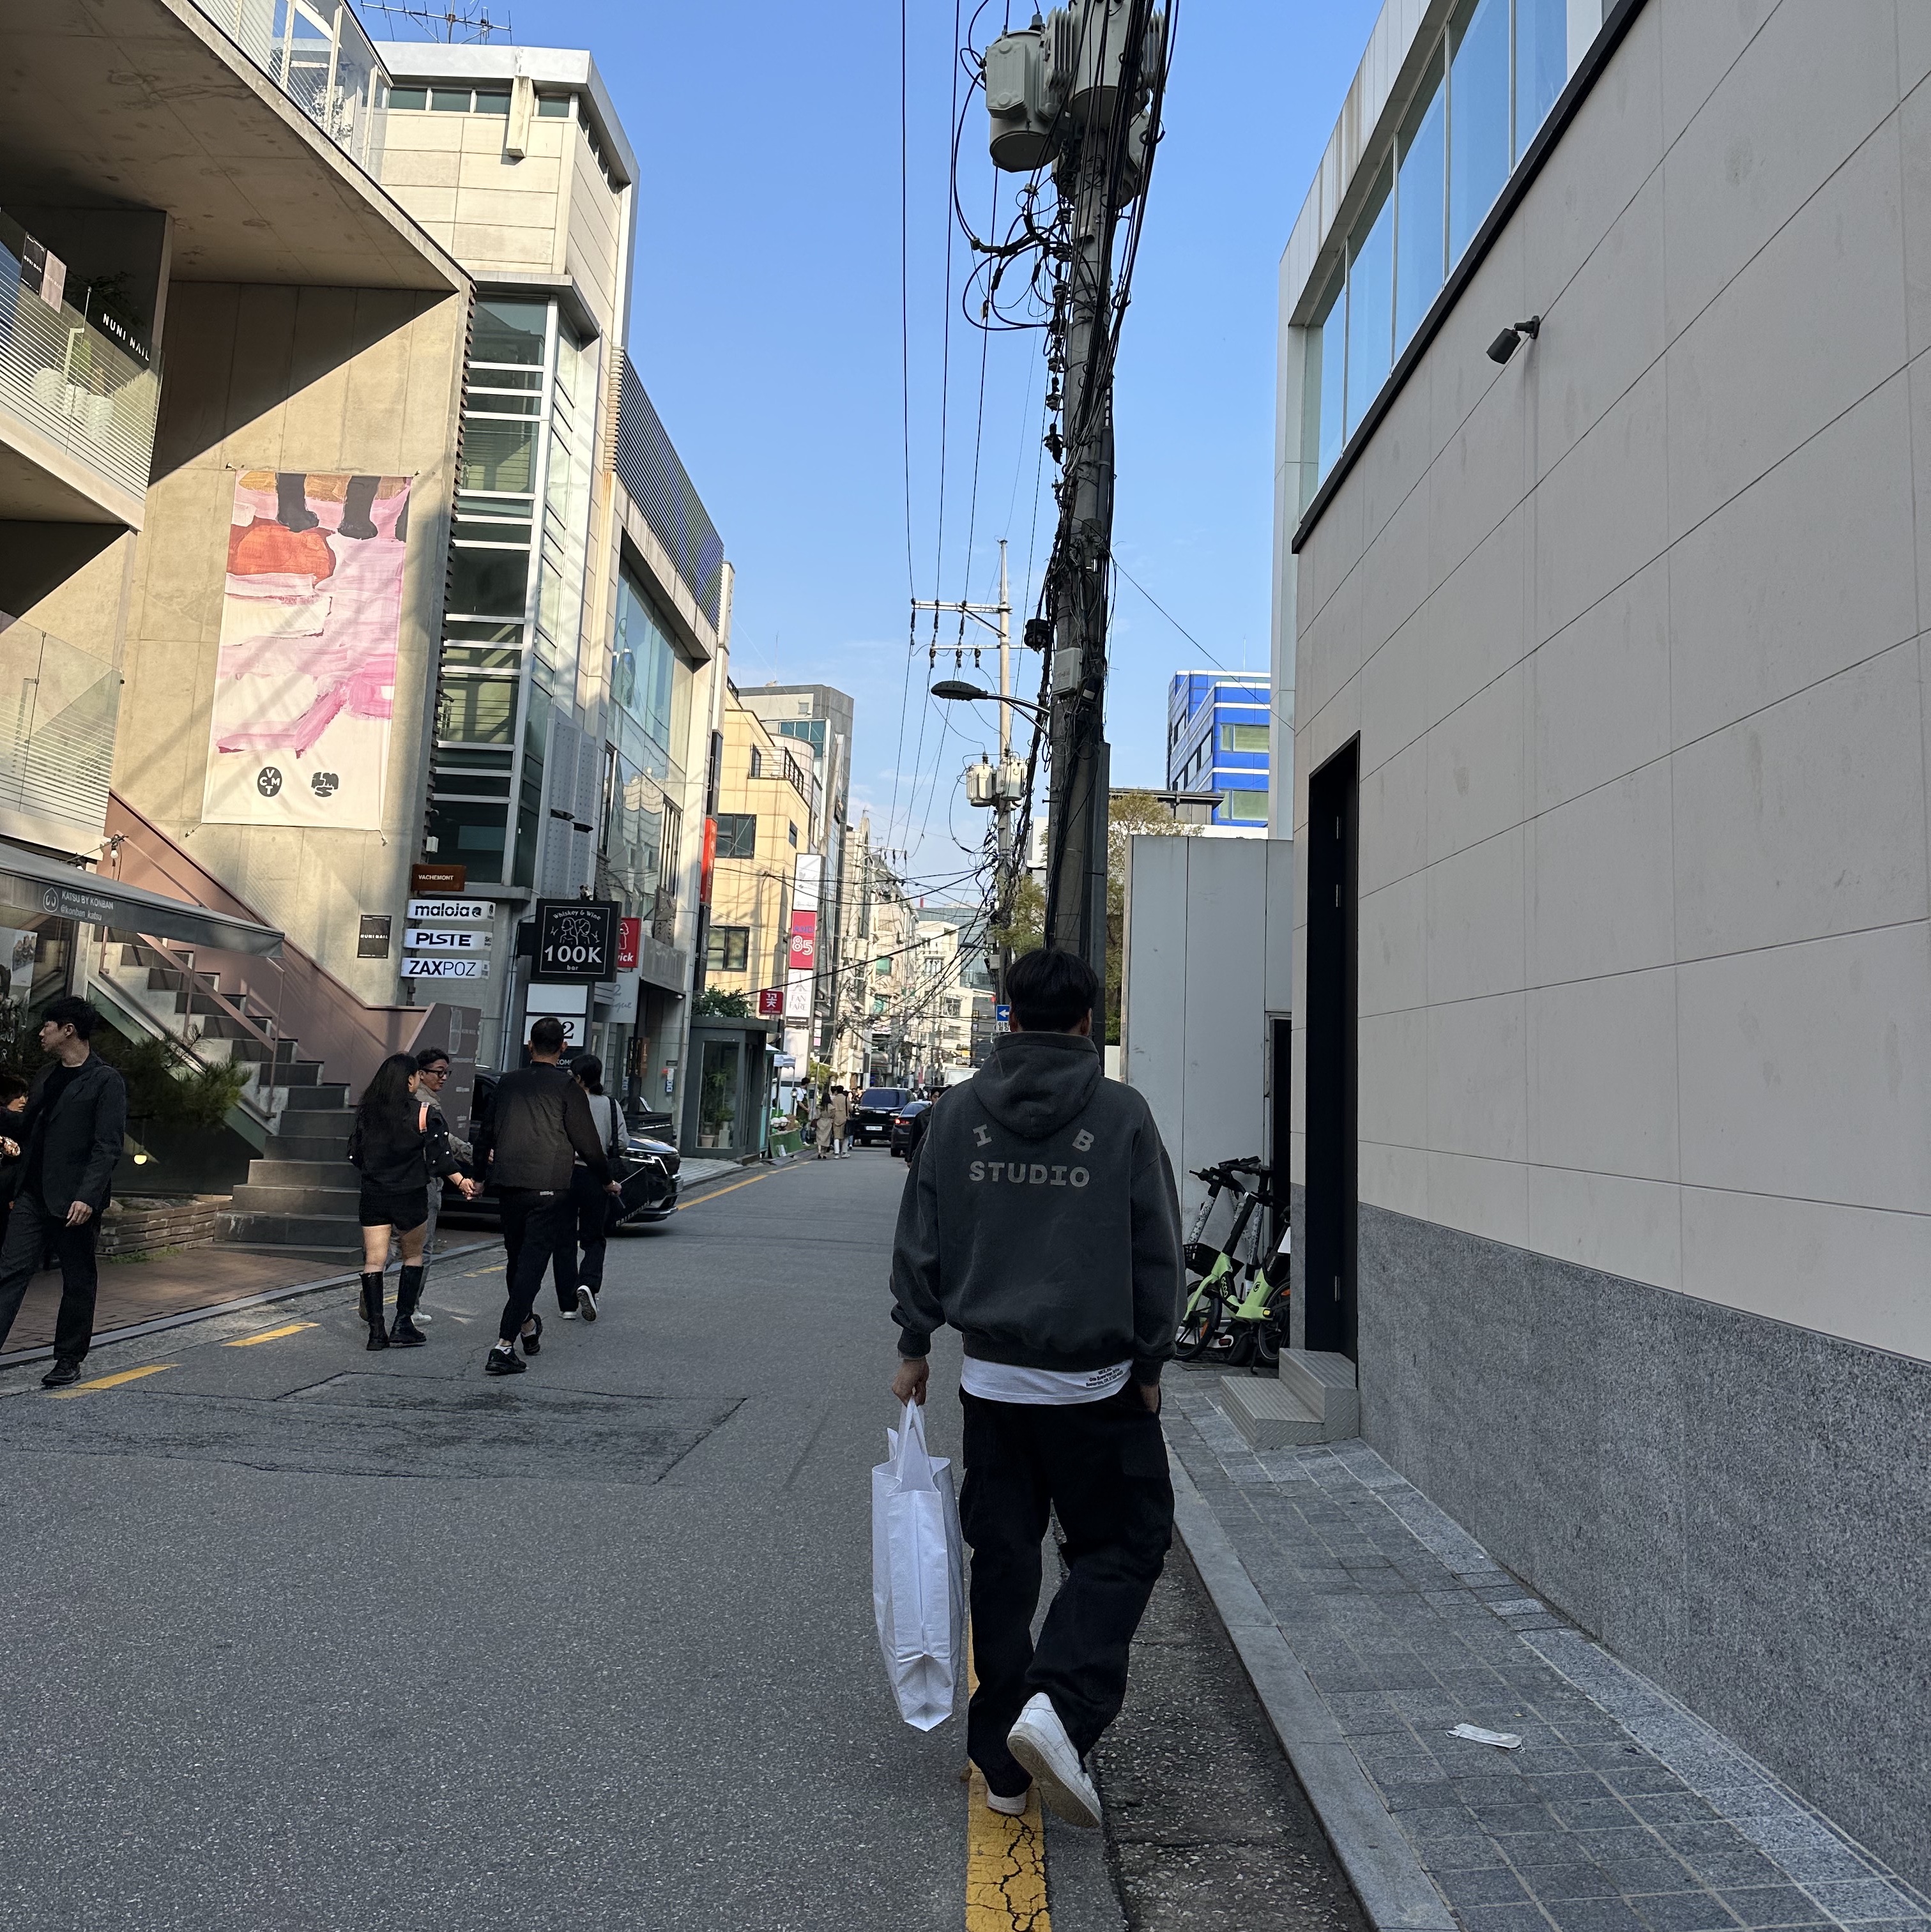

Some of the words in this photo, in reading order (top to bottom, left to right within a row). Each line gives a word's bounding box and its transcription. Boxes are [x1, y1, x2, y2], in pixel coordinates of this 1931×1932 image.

[103, 313, 126, 340] NUNI
[129, 337, 149, 361] NAIL
[61, 890, 80, 903] KATSU
[81, 895, 89, 905] BY
[90, 897, 114, 909] KONBAN
[415, 902, 470, 917] maloja
[553, 910, 579, 919] Whiskey
[586, 910, 601, 920] Wine
[544, 945, 602, 963] 100K
[792, 935, 813, 956] 85
[618, 952, 634, 962] ick
[409, 960, 477, 977] ZAXPOZ
[766, 993, 777, 1008] 꽃
[790, 1001, 807, 1011] FARE
[791, 994, 806, 1003] FAN
[972, 1123, 993, 1148] I
[1072, 1128, 1095, 1152] B
[968, 1160, 1090, 1188] STUDIO
